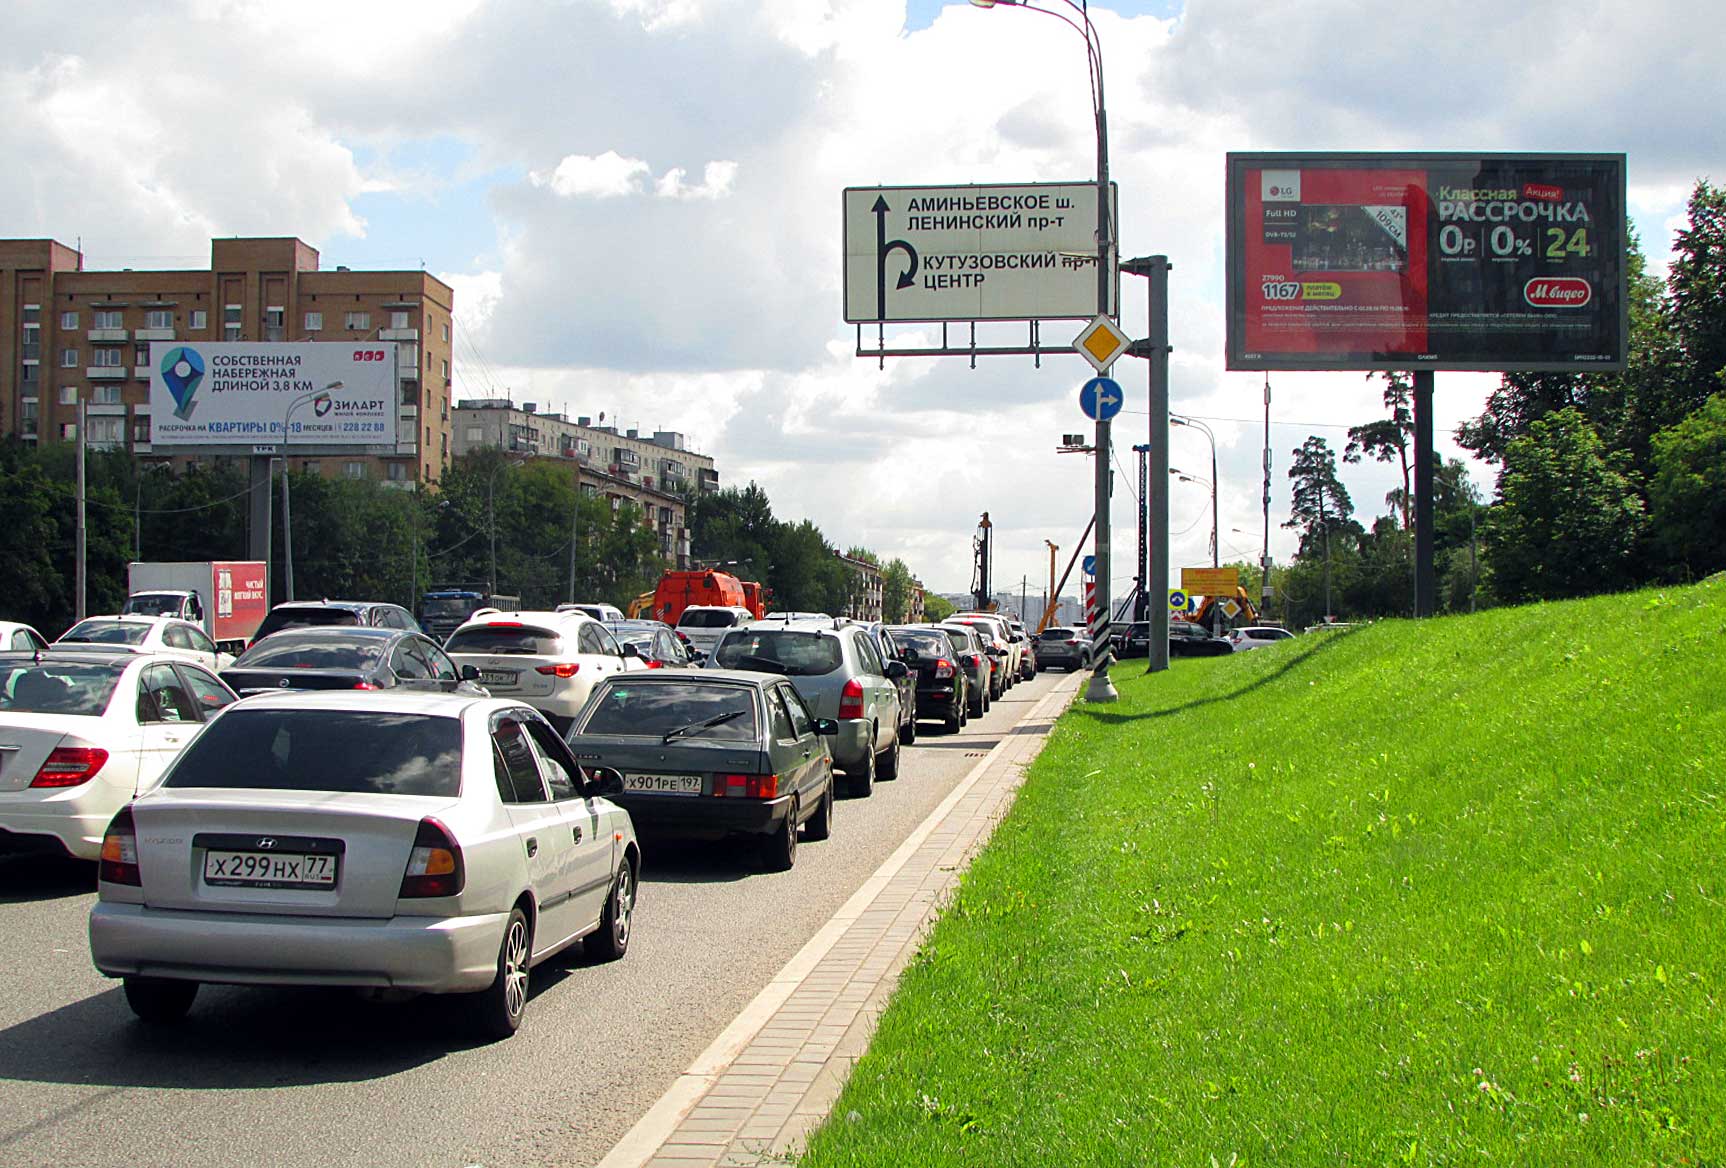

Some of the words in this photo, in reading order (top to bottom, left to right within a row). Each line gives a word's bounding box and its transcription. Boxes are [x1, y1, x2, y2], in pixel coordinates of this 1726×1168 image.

[1280, 187, 1293, 195] LG
[1440, 186, 1517, 201] Классная
[908, 195, 1050, 212] АМИНЬЕВСКОЕ
[1055, 198, 1075, 209] ш.
[1265, 209, 1281, 217] Full
[1283, 209, 1297, 217] HD
[1440, 202, 1590, 222] РАССРОЧКА
[907, 211, 1022, 231] ЛЕНИНСКИЙ
[1028, 217, 1065, 231] пр-т
[1546, 228, 1590, 257] 24
[923, 251, 1056, 270] КУТУЗОВСКИЙ
[924, 274, 985, 291] ЦЕНТР
[1263, 283, 1299, 298] 1167
[212, 355, 301, 366] СОБСТВЕННАЯ
[212, 368, 296, 379] НАБЕРЕЖНАЯ
[212, 379, 270, 392] ДЛИНОЙ
[272, 381, 291, 392] 3,8
[294, 381, 313, 391] КМ
[334, 401, 384, 410] ЗИЛАРТ
[159, 424, 196, 432] РАССРОЧКА
[208, 421, 267, 432] КВАРТИРЫ
[680, 777, 699, 787] 197
[214, 855, 300, 879] Х299НХ
[307, 857, 328, 874] 77
